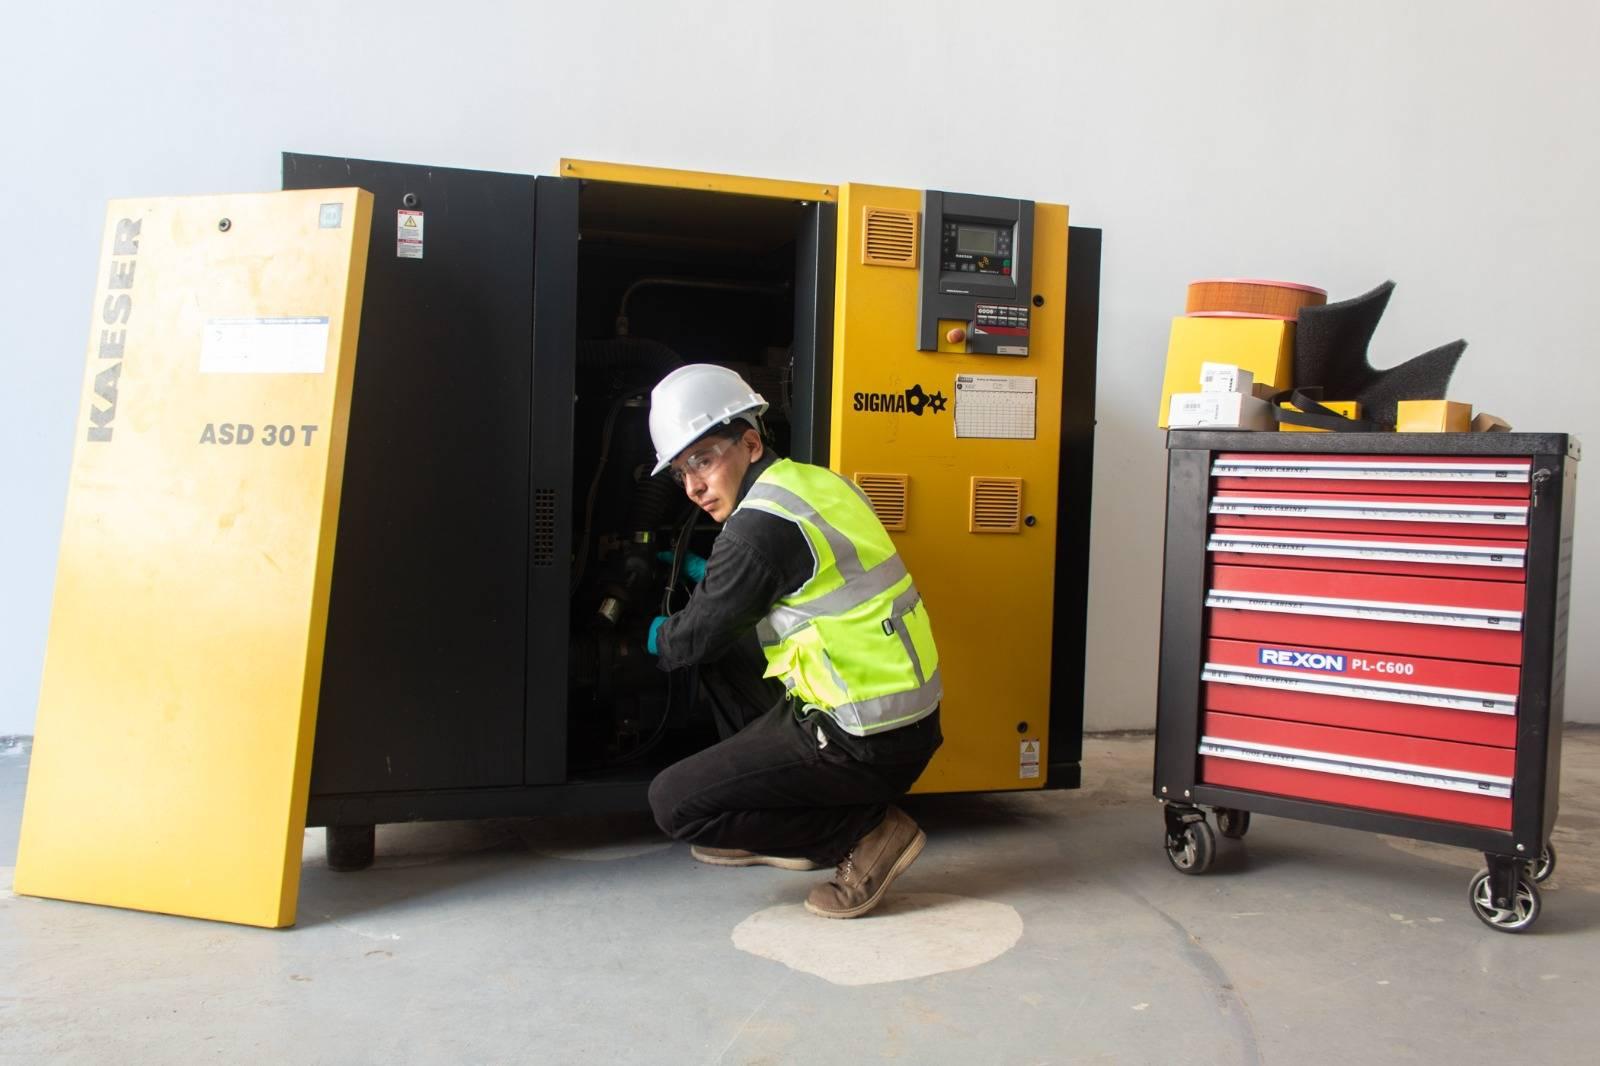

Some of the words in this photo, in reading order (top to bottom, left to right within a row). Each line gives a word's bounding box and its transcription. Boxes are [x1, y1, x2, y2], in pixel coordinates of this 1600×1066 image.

[87, 218, 143, 442] KAESER
[853, 392, 905, 413] SIGMA
[199, 423, 255, 446] ASD
[261, 424, 296, 447] 30
[300, 425, 319, 447] T
[1261, 649, 1343, 671] REXON
[1352, 659, 1415, 676] PL-C600
